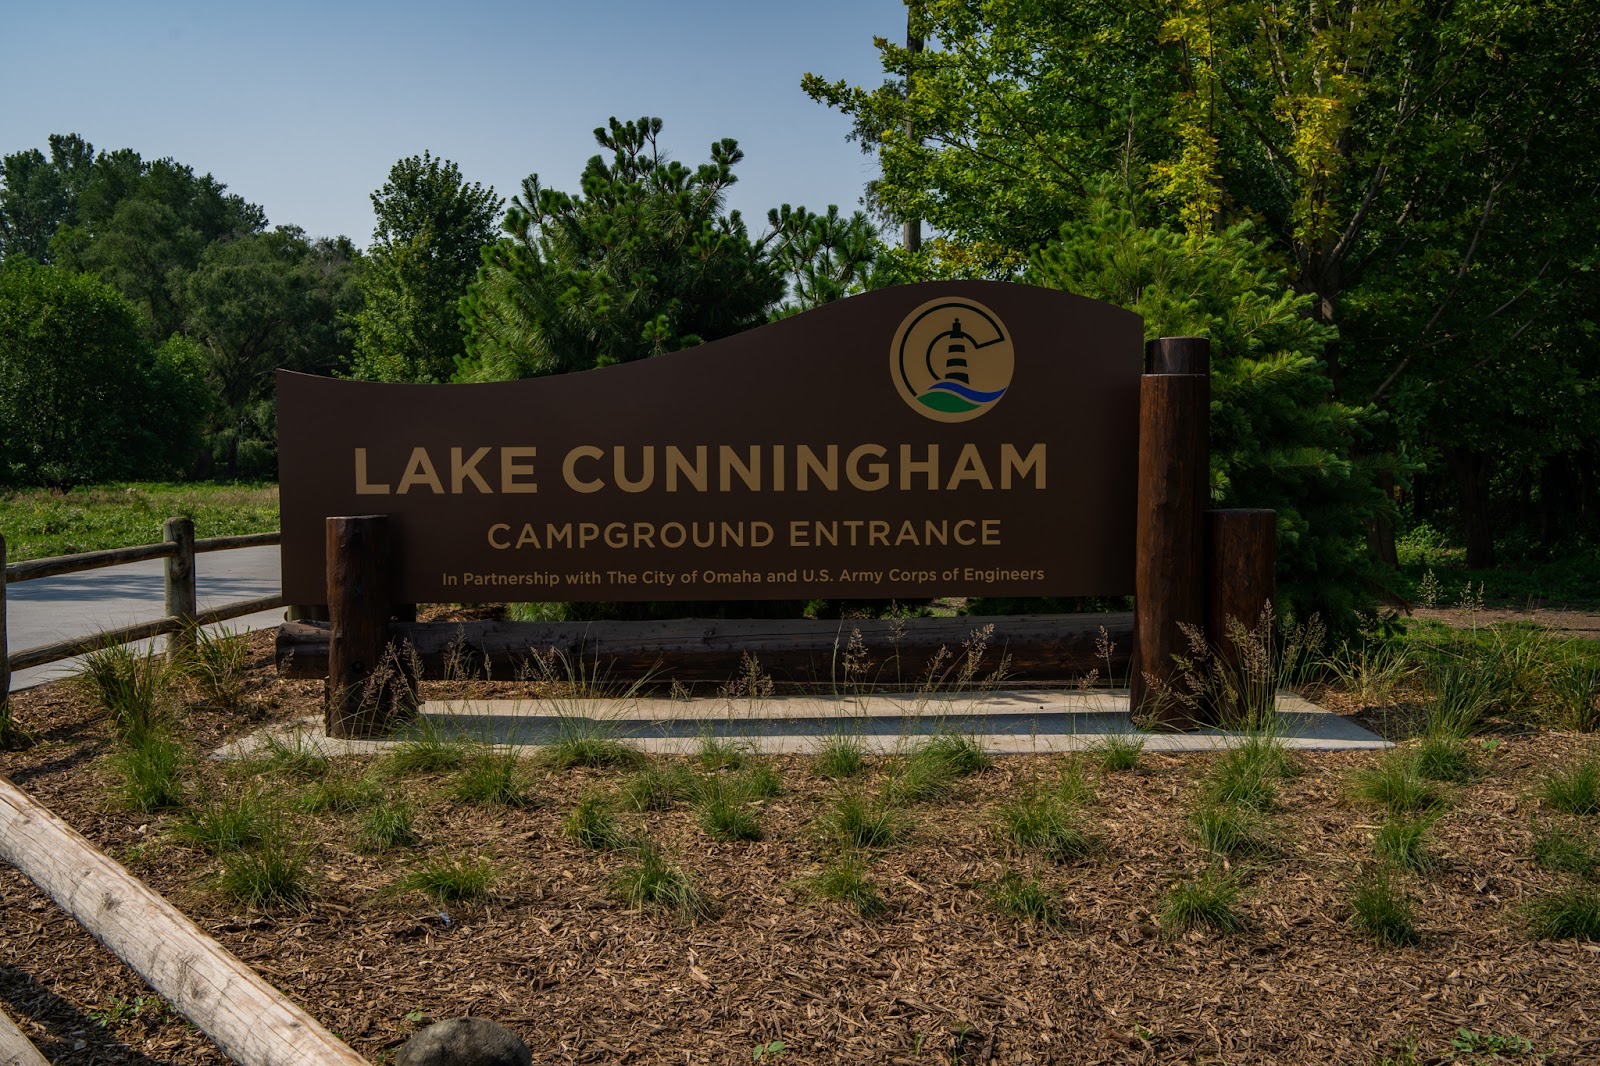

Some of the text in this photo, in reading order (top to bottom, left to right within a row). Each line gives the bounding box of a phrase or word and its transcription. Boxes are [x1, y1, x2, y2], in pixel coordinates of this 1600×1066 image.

[354, 443, 1047, 495] LAKE CUNNINGHAM
[487, 519, 1002, 550] CAMPGROUND ENTRANCE
[442, 567, 1045, 587] In Partnership with The City of Omaha and U.S. Army Corps of Engineers
